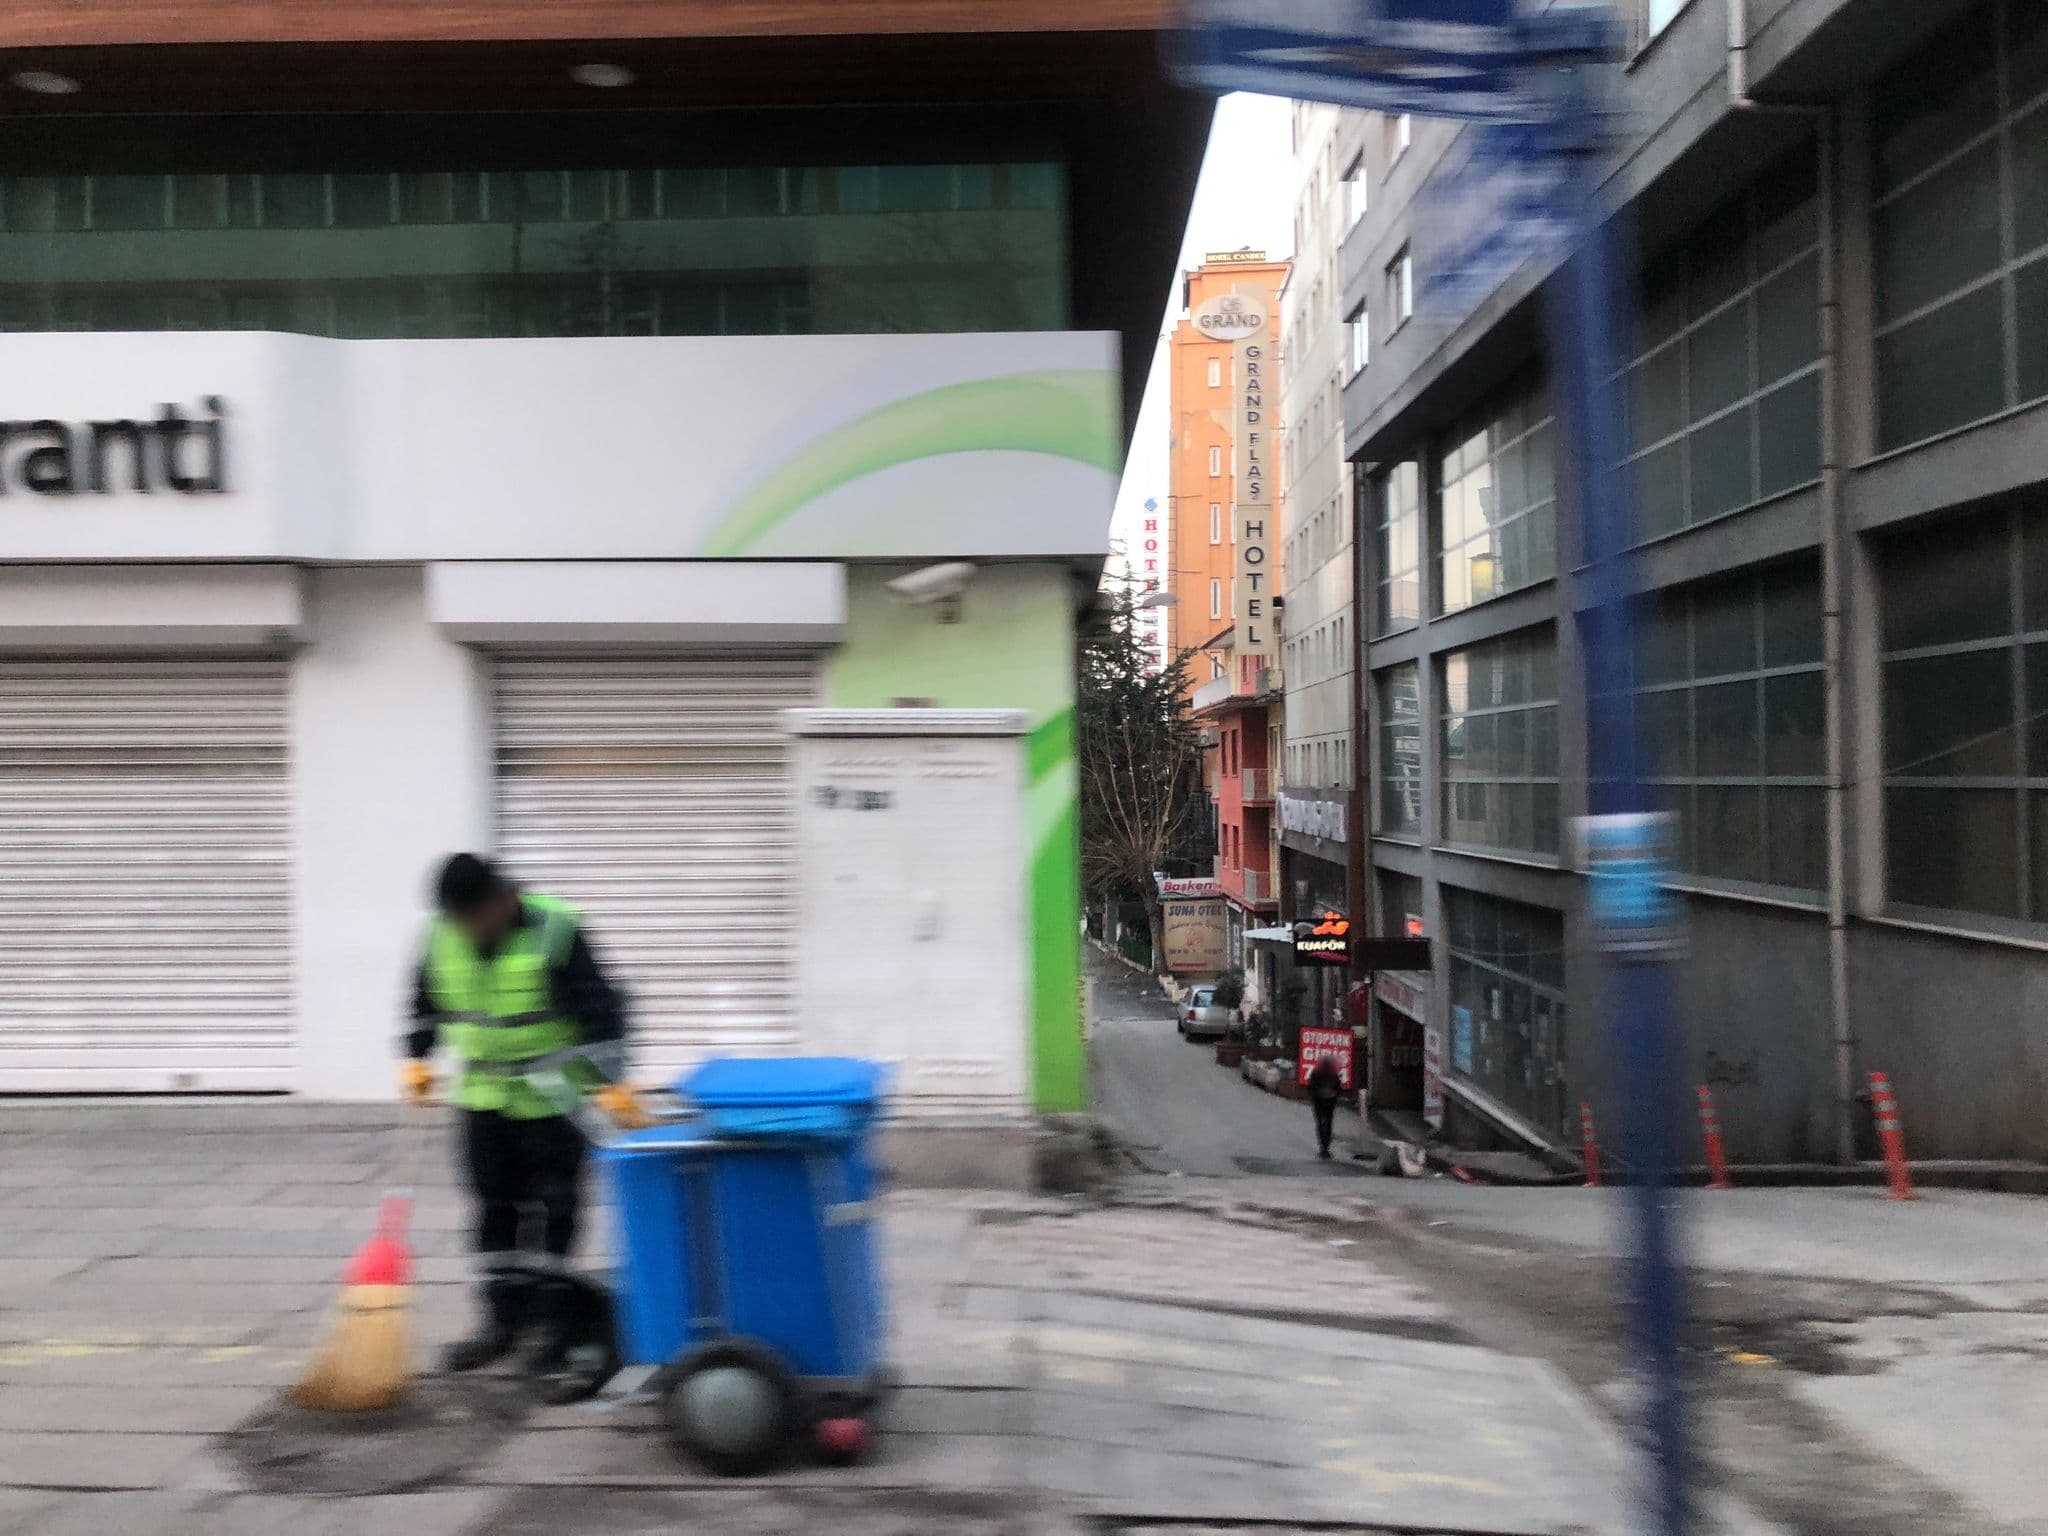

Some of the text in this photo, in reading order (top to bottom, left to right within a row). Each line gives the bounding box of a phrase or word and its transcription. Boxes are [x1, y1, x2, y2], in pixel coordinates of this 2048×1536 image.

[1200, 314, 1261, 328] GRAND
[1244, 345, 1265, 643] GRAND FLAS HOTEL
[1144, 519, 1158, 612] HOTE
[1163, 880, 1222, 892] Başken
[1302, 1031, 1350, 1047] OTOPARK
